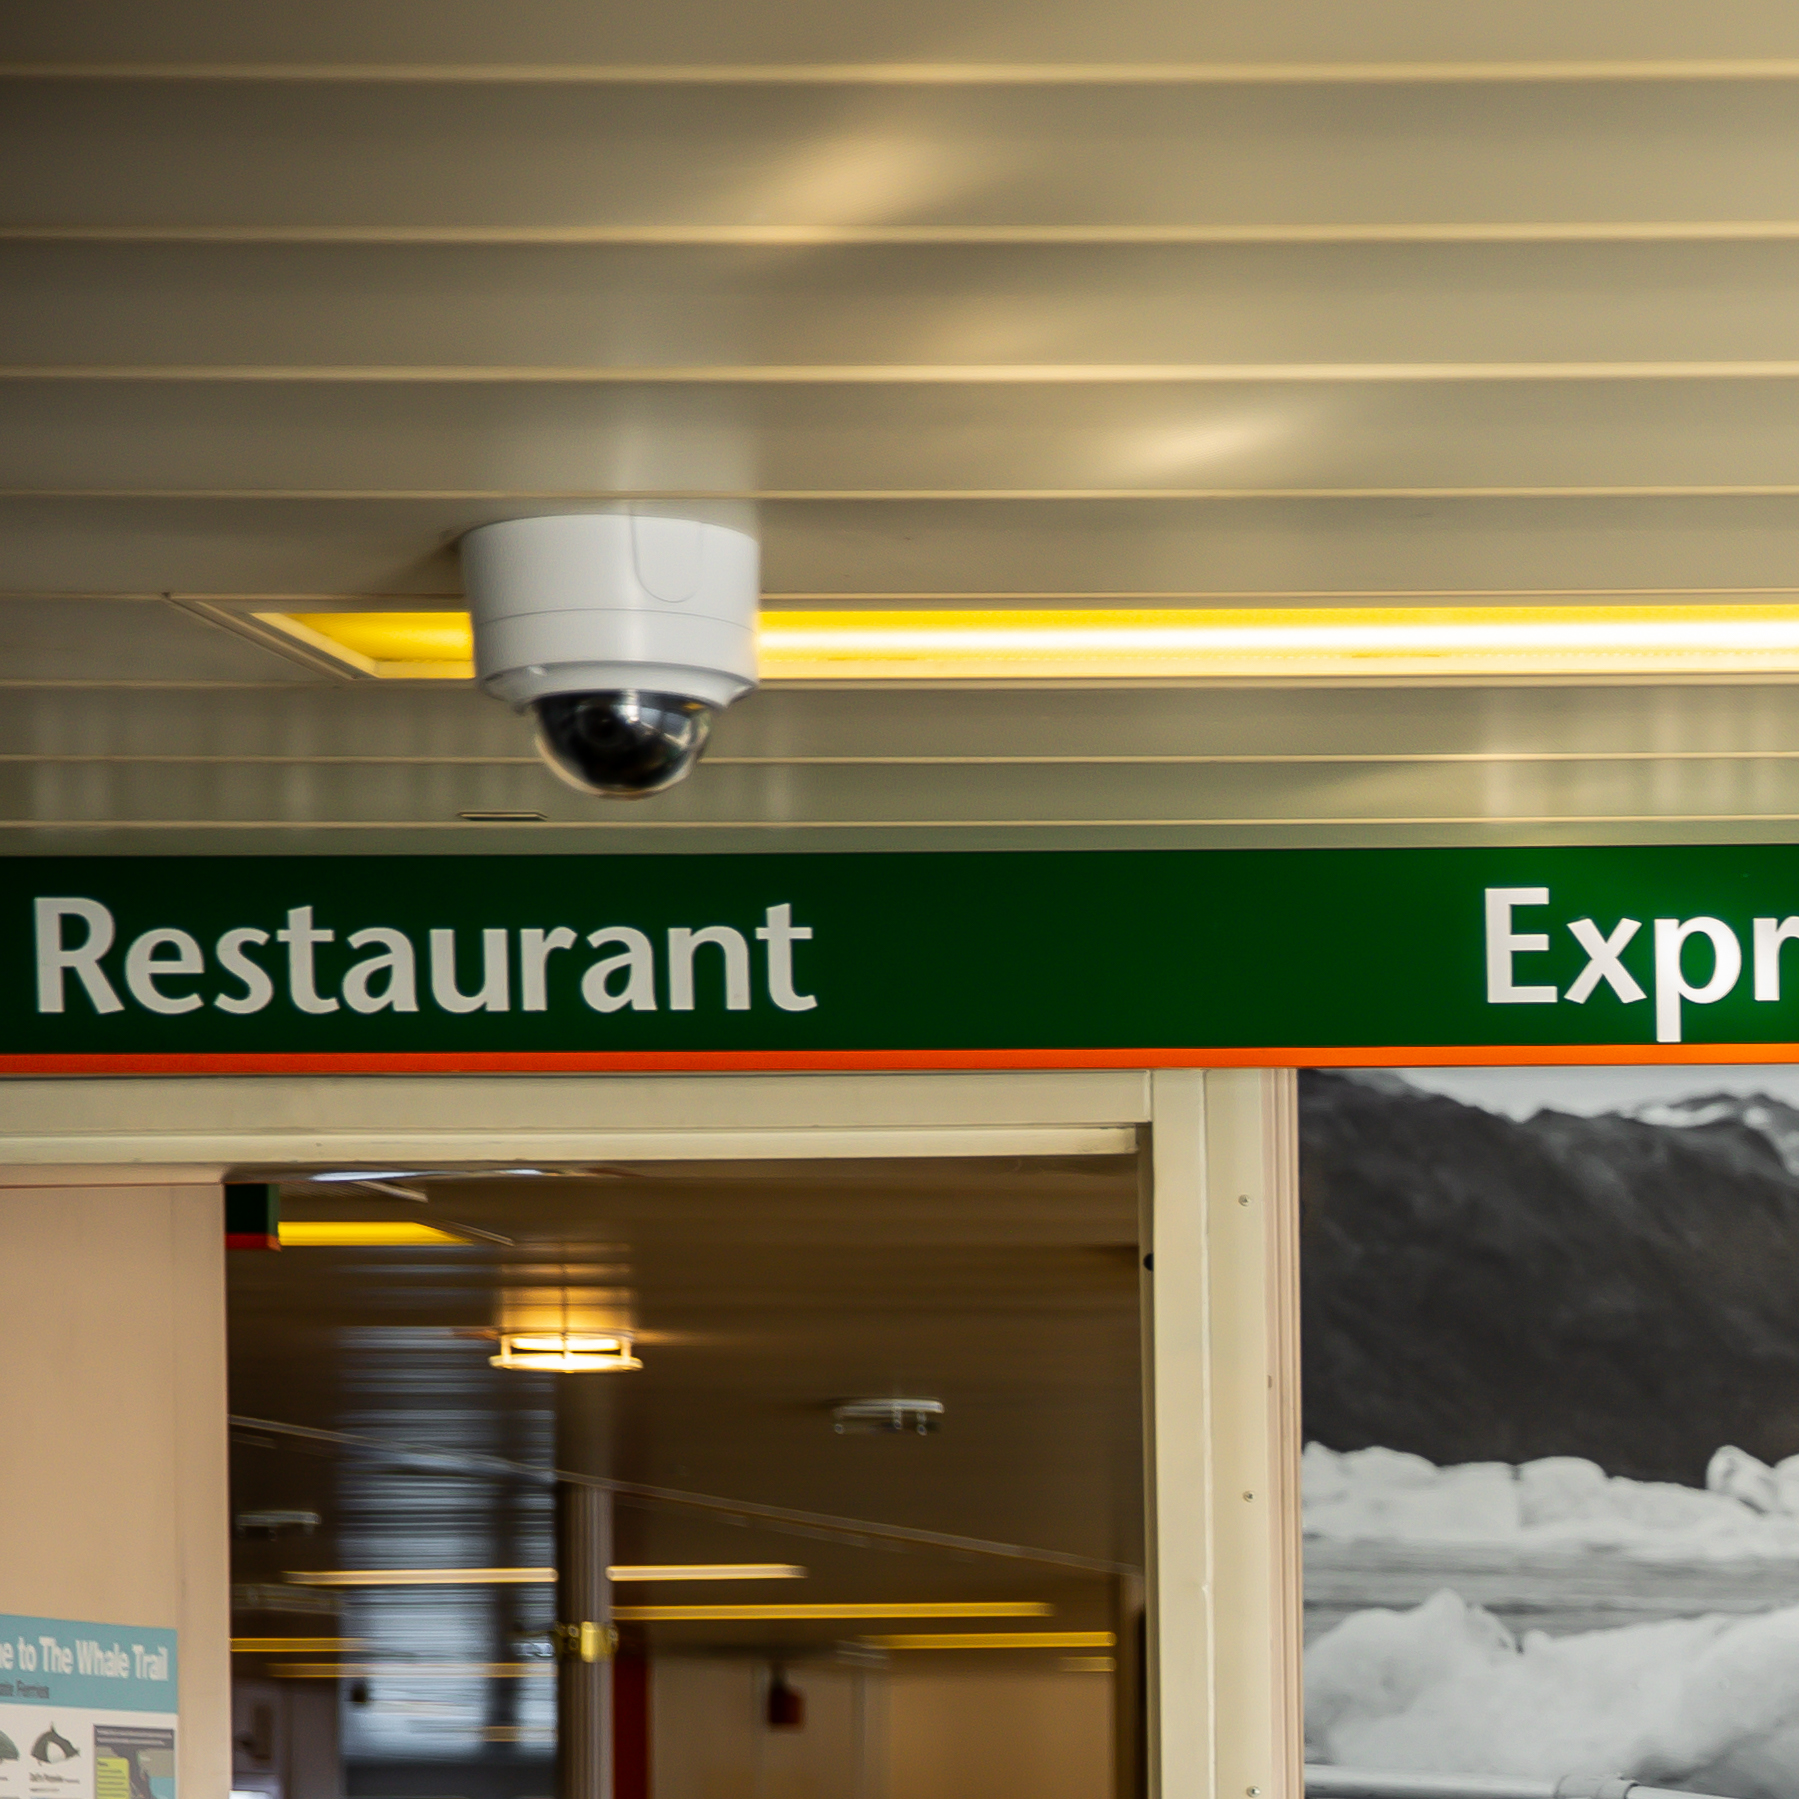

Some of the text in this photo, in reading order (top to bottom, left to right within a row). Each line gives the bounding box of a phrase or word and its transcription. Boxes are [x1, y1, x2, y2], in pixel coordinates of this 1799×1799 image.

[34, 897, 818, 1014] Restaurant
[17, 1636, 37, 1672] to
[39, 1636, 74, 1675] The
[75, 1639, 130, 1679] Whale
[131, 1644, 169, 1681] Trail
